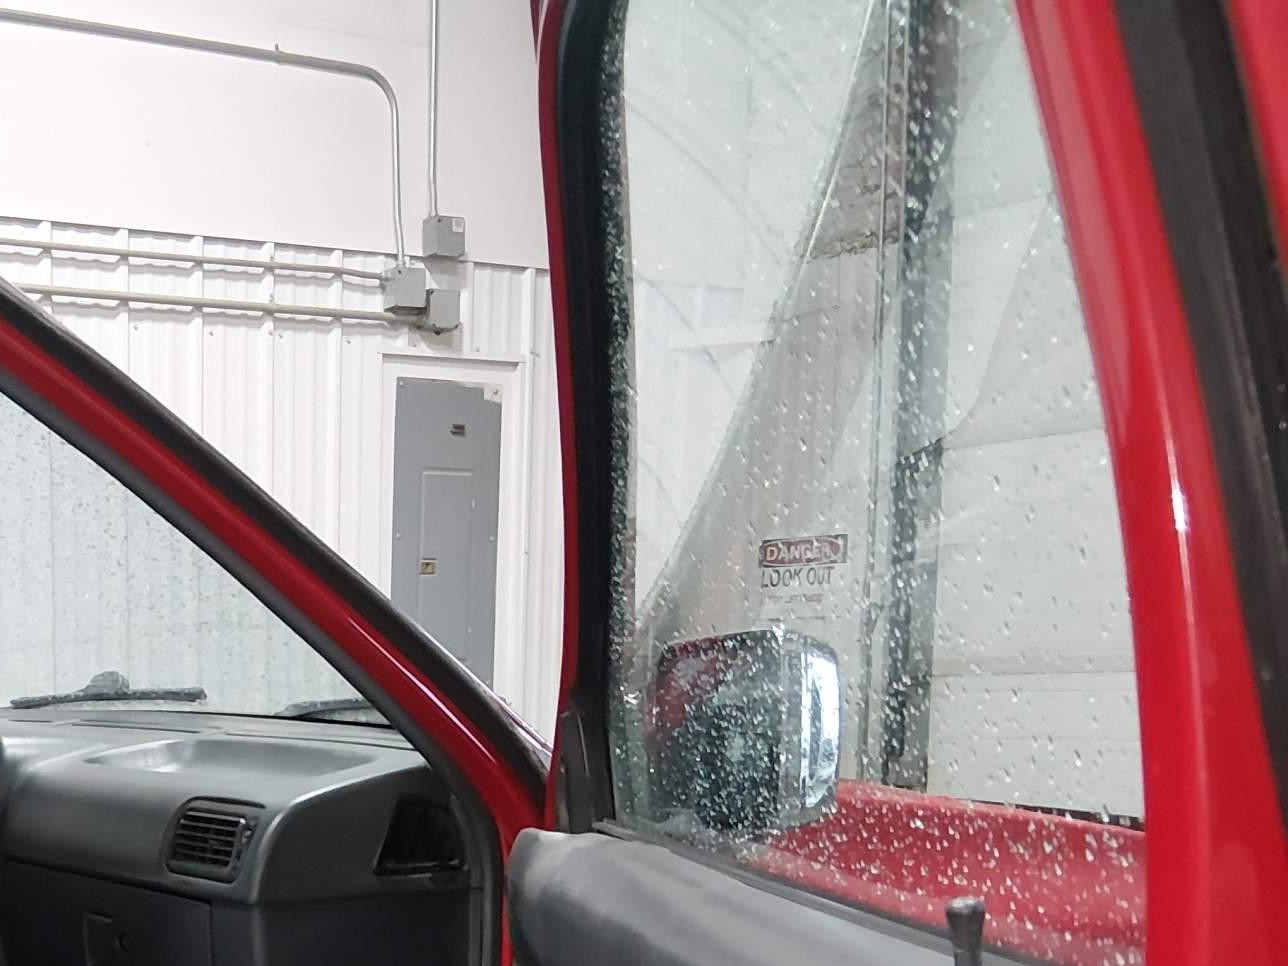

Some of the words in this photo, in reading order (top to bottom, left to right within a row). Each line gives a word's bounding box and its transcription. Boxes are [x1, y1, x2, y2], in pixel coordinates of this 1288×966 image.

[766, 542, 832, 561] DANGER
[760, 567, 803, 588] LOOK
[806, 566, 834, 585] OUT
